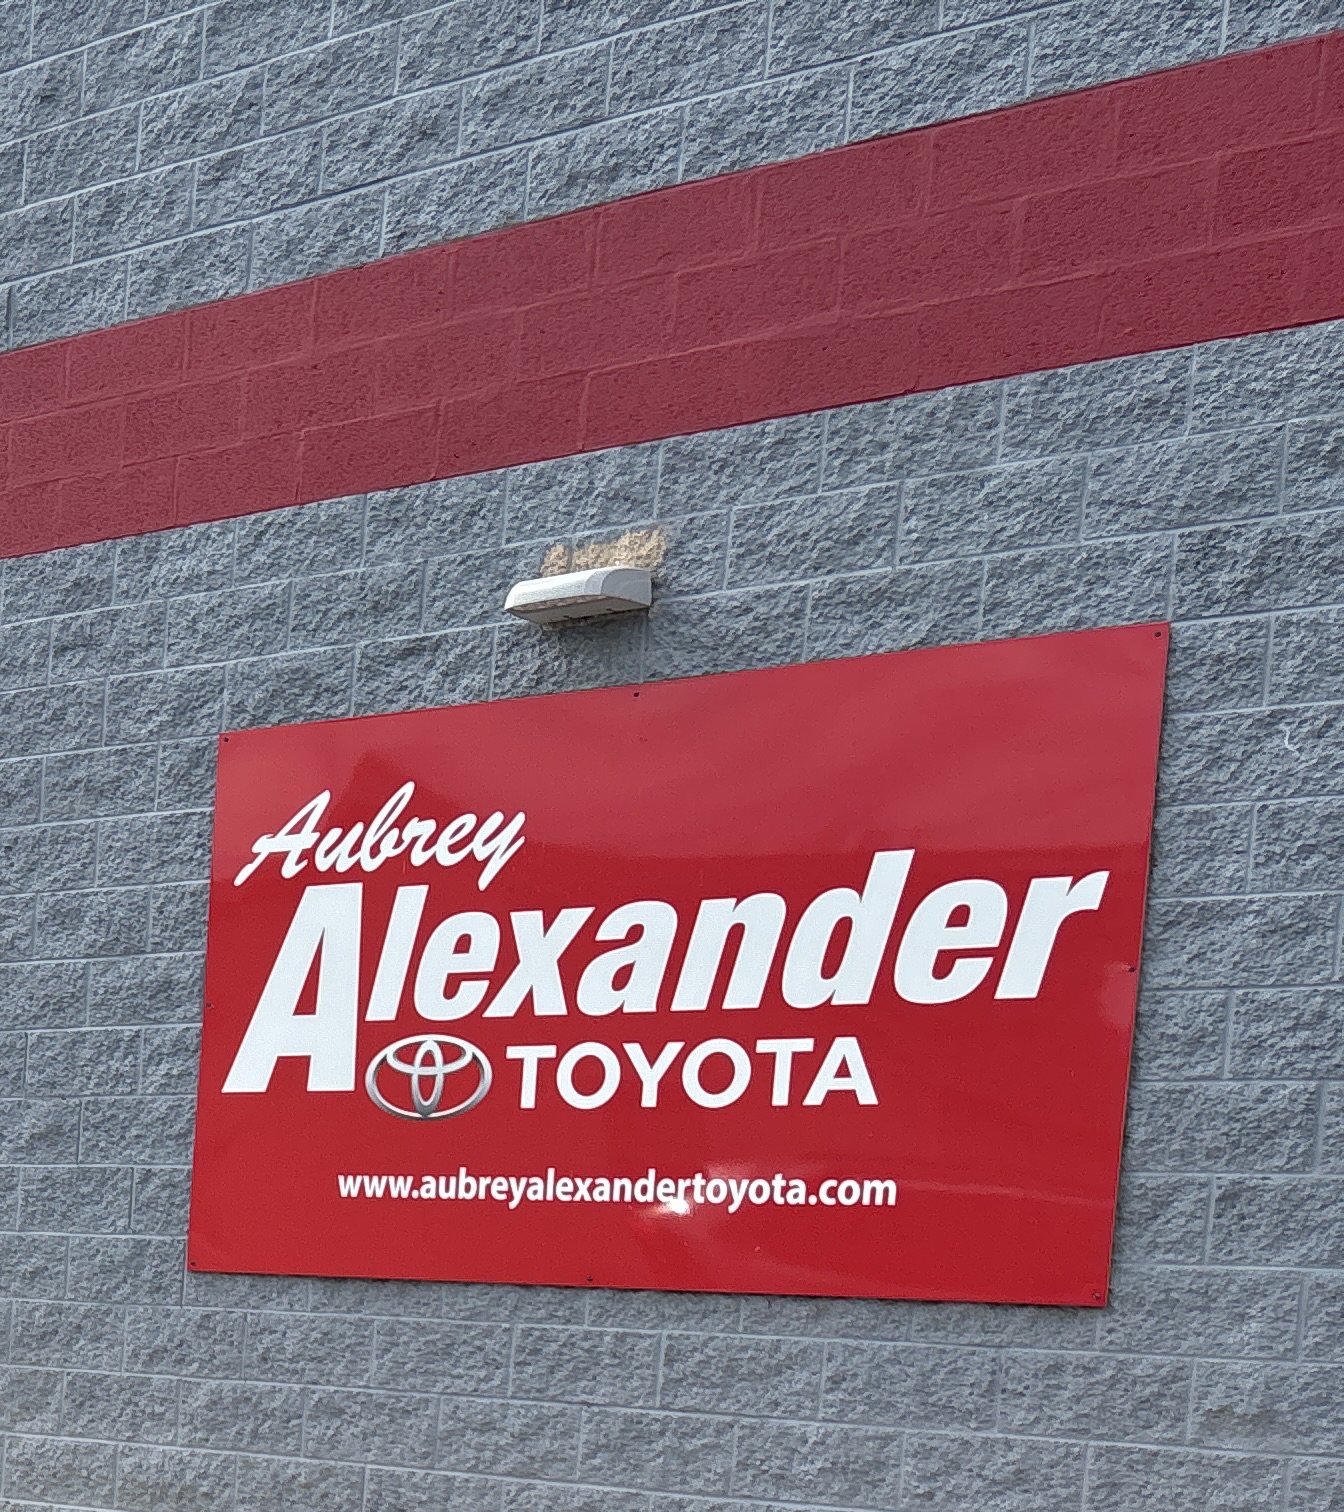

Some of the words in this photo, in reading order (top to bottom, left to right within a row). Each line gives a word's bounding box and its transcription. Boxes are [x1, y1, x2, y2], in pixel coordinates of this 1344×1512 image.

[234, 781, 526, 891] Aubrey
[221, 848, 1110, 1094] Alexander
[505, 1036, 879, 1110] TOYOTA
[337, 1166, 898, 1214] www.aubreyalexandertoyota.com
